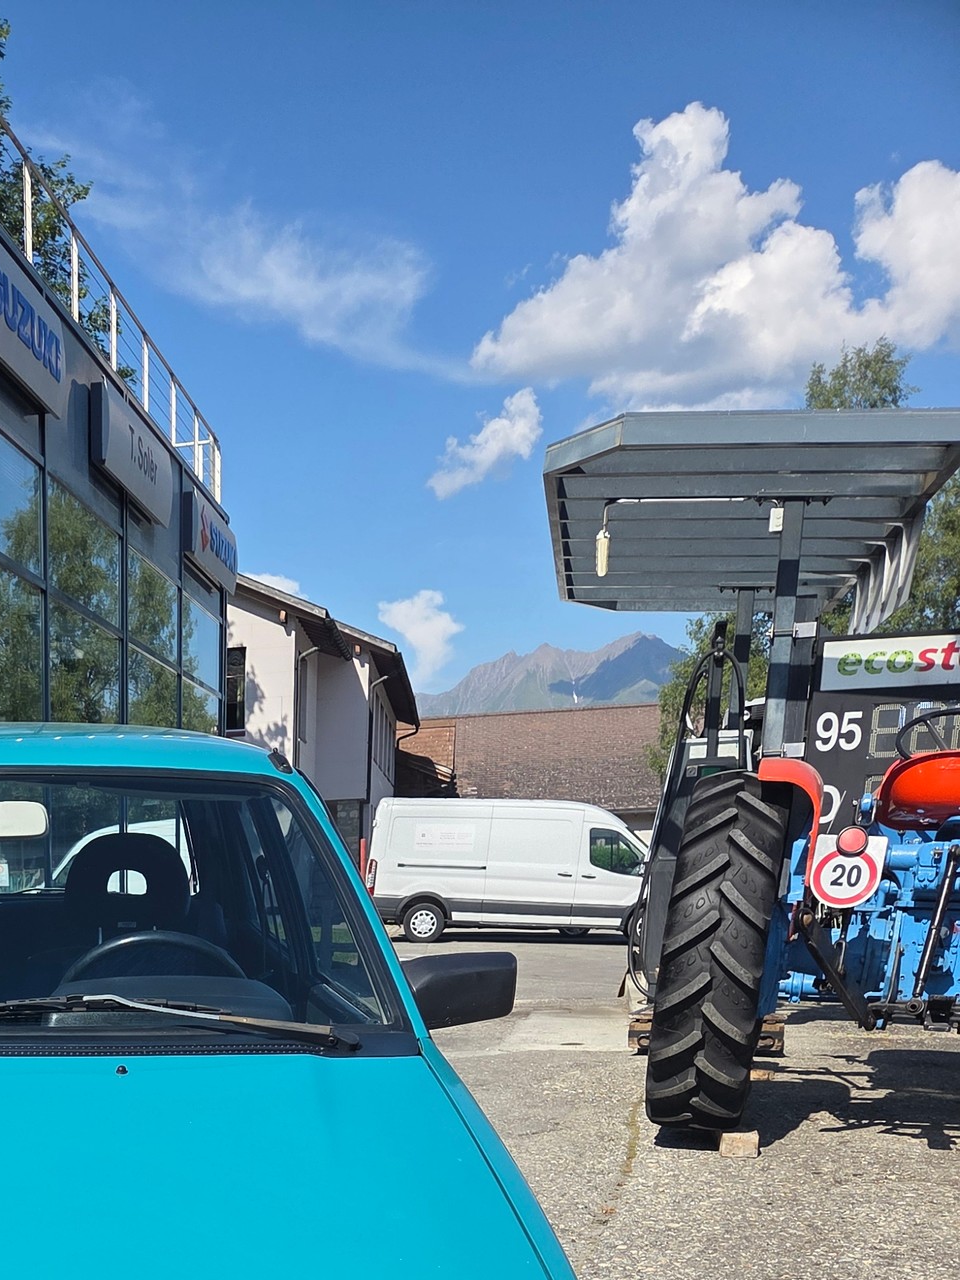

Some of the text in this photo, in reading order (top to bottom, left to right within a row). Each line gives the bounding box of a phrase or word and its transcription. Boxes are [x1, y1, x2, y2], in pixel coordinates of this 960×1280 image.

[209, 520, 237, 577] SUZUKI
[837, 640, 960, 676] ecost
[815, 711, 863, 752] 95
[830, 863, 862, 888] 20
